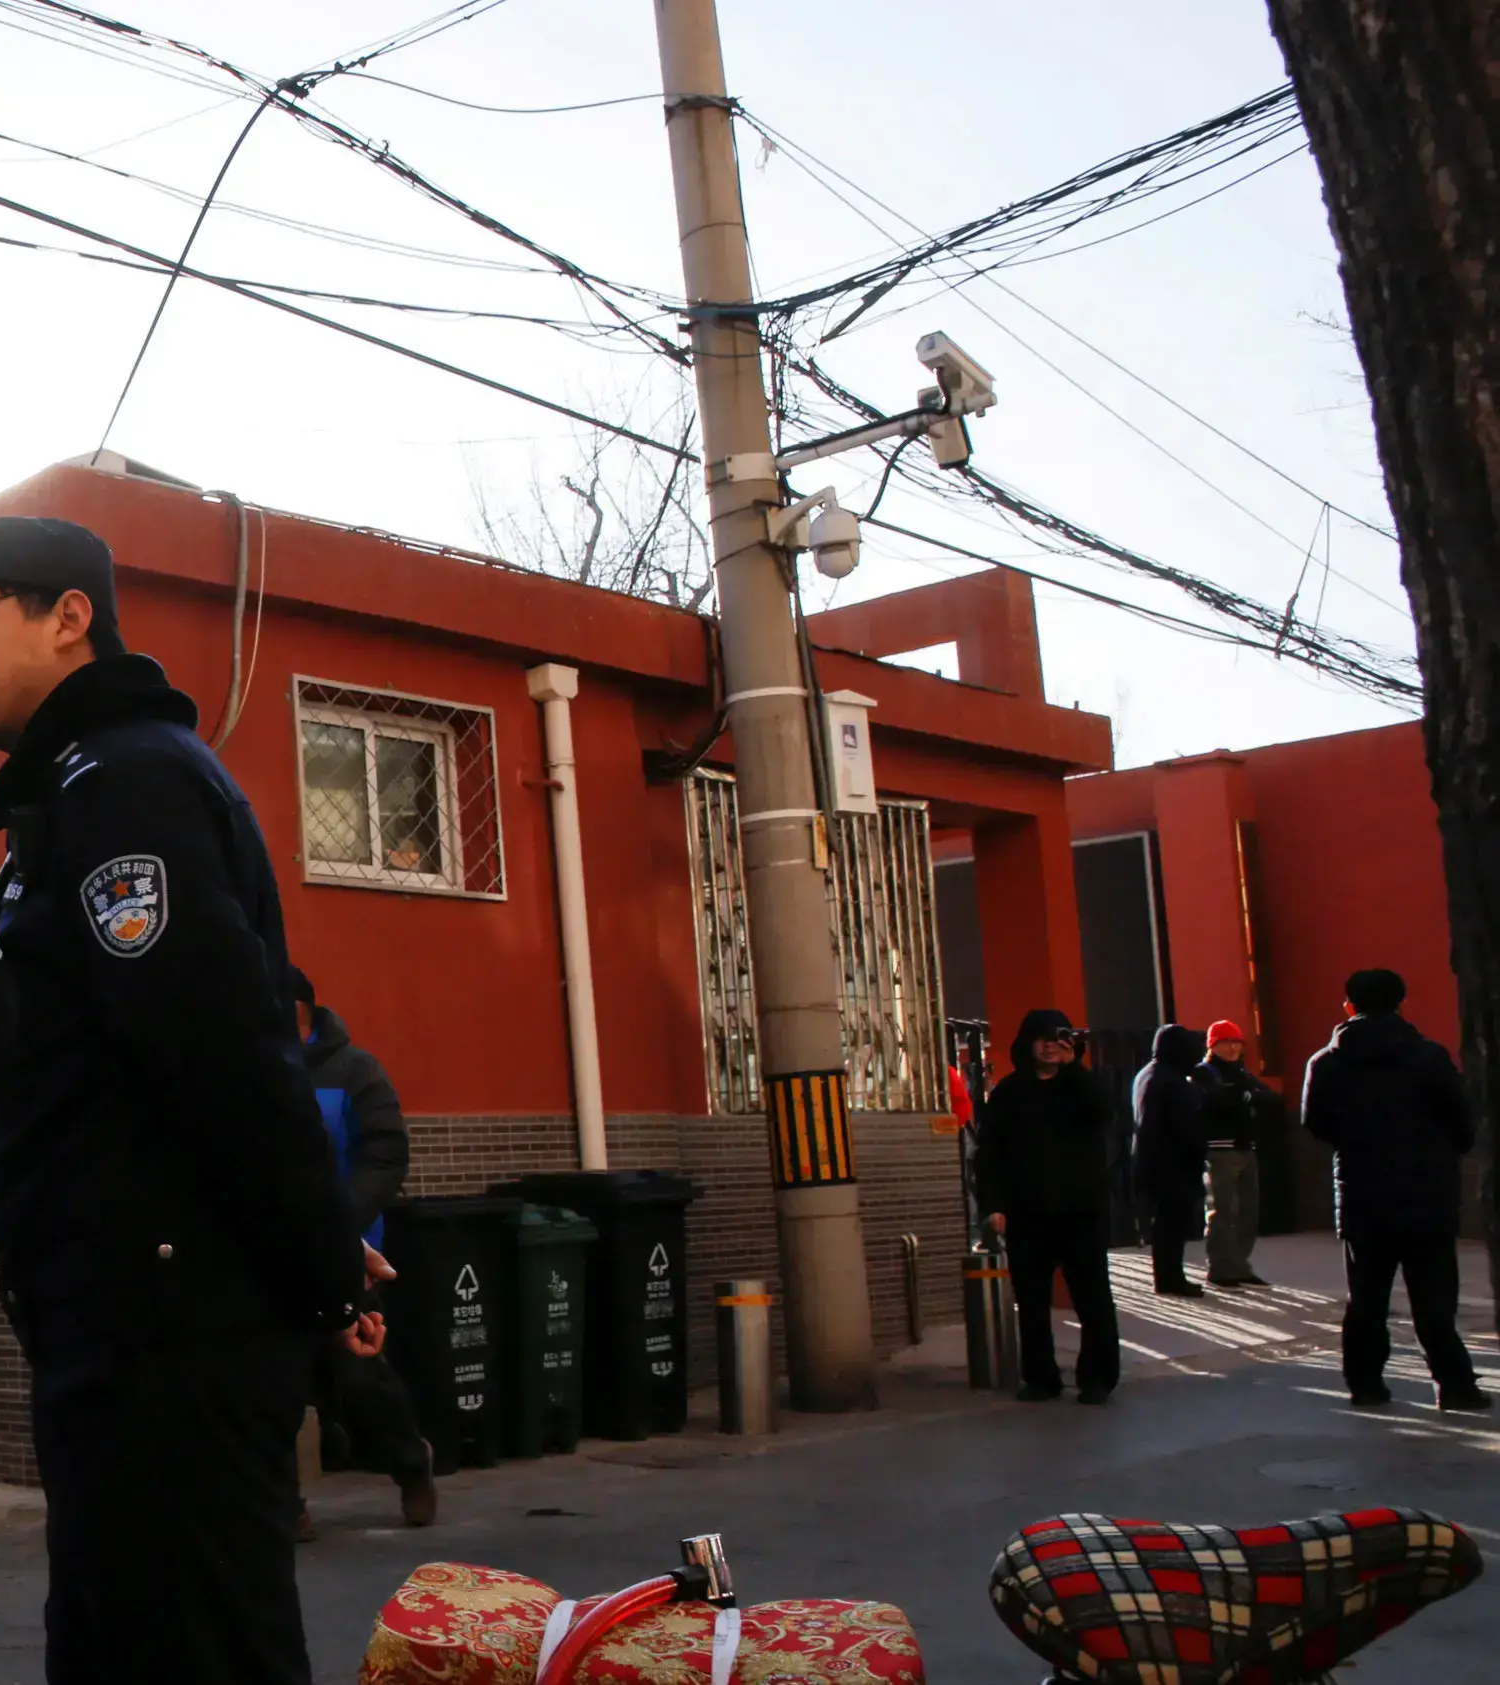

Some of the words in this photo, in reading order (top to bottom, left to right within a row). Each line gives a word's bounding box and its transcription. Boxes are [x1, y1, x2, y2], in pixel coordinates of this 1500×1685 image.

[87, 862, 155, 898] 中华人民共和国
